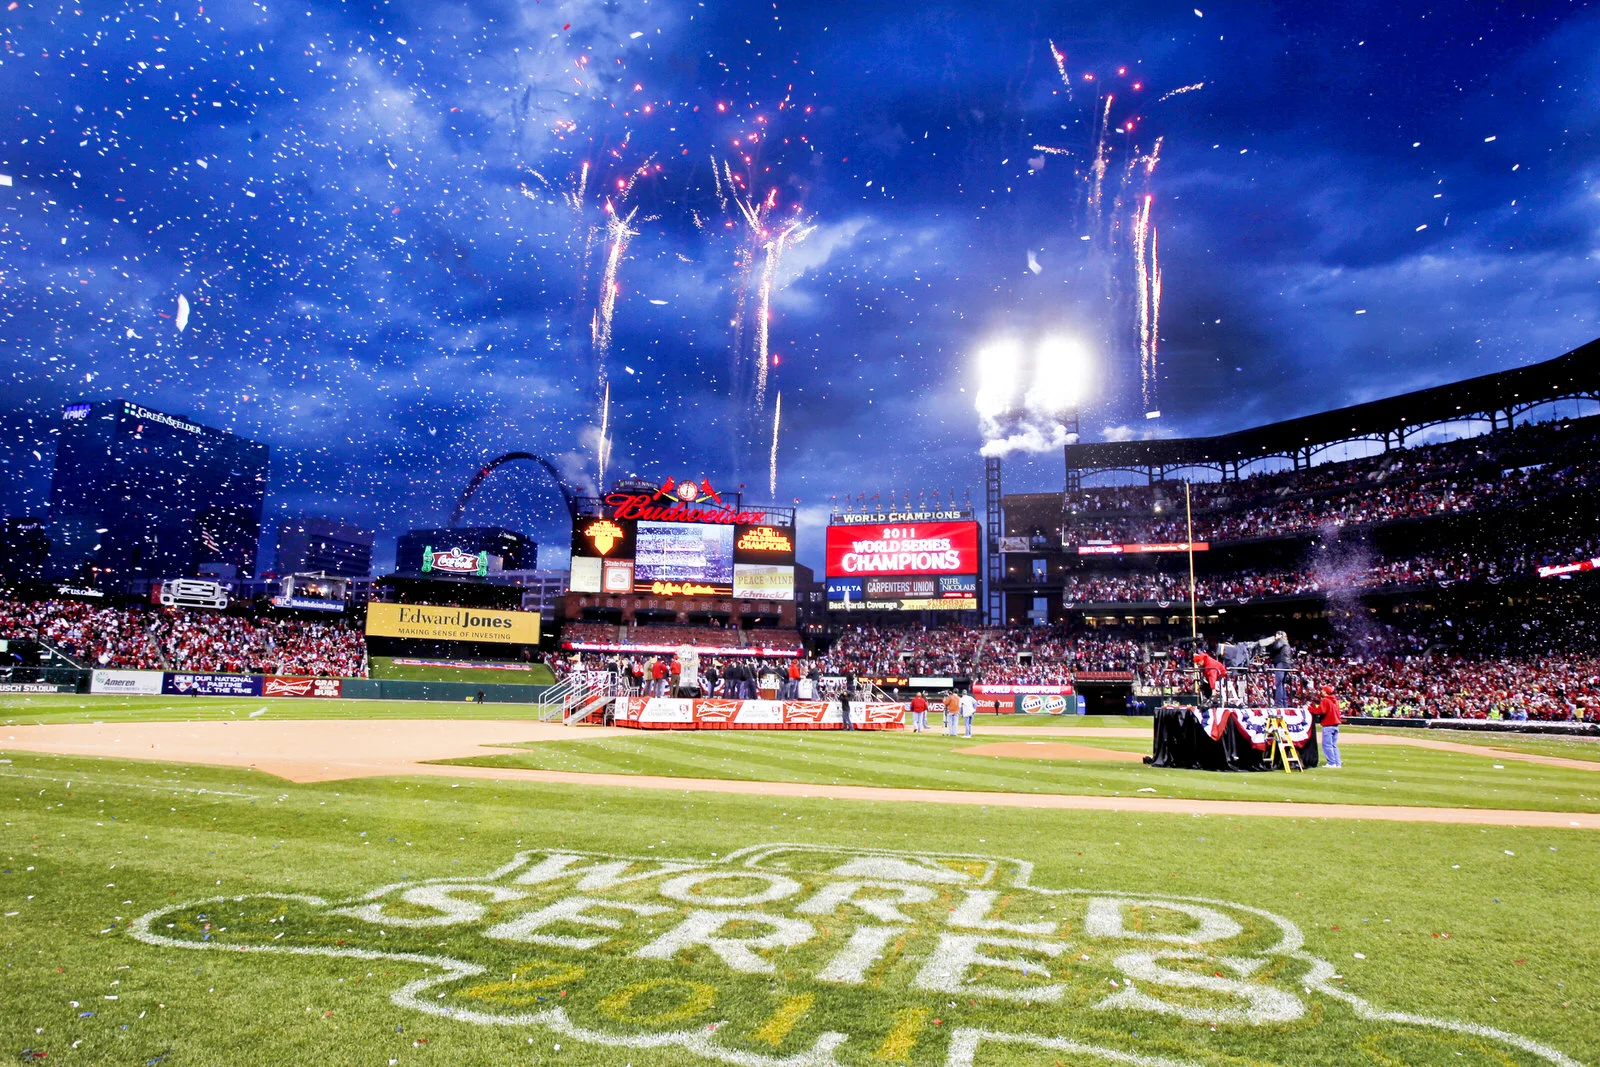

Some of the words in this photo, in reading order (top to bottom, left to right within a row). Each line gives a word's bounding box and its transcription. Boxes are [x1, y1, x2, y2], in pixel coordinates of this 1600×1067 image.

[63, 409, 87, 420] KPMG
[138, 406, 202, 435] GREENSFELDER
[605, 494, 766, 525] Budweiser
[843, 514, 886, 523] WORLD
[888, 511, 961, 522] CHAMPIONS
[883, 528, 916, 538] 2011
[738, 540, 791, 551] CHAMPIONS
[852, 540, 900, 553] WORLD
[900, 538, 951, 552] SERIES
[438, 554, 474, 568] Coca-Cola
[842, 550, 960, 572] CHAMPIONS
[738, 576, 764, 584] PEACE
[868, 582, 912, 592] CARPENTERS'
[913, 581, 934, 592] UNION
[738, 590, 789, 598] Schnucks
[866, 601, 897, 611] Coverage
[399, 607, 460, 625] Edward
[462, 612, 512, 629] Jones
[104, 678, 135, 686] Ameren
[266, 682, 311, 691] Budweiser
[982, 685, 1011, 694] WORLD
[1012, 685, 1061, 694] CHAMPIONS
[696, 704, 736, 712] Budweiser
[977, 700, 995, 708] State
[1023, 700, 1041, 709] Gulf
[1046, 701, 1063, 709] Gulf
[513, 853, 1243, 944] WORLD
[335, 884, 1308, 1026] SERIES
[456, 959, 932, 1063] 2011
